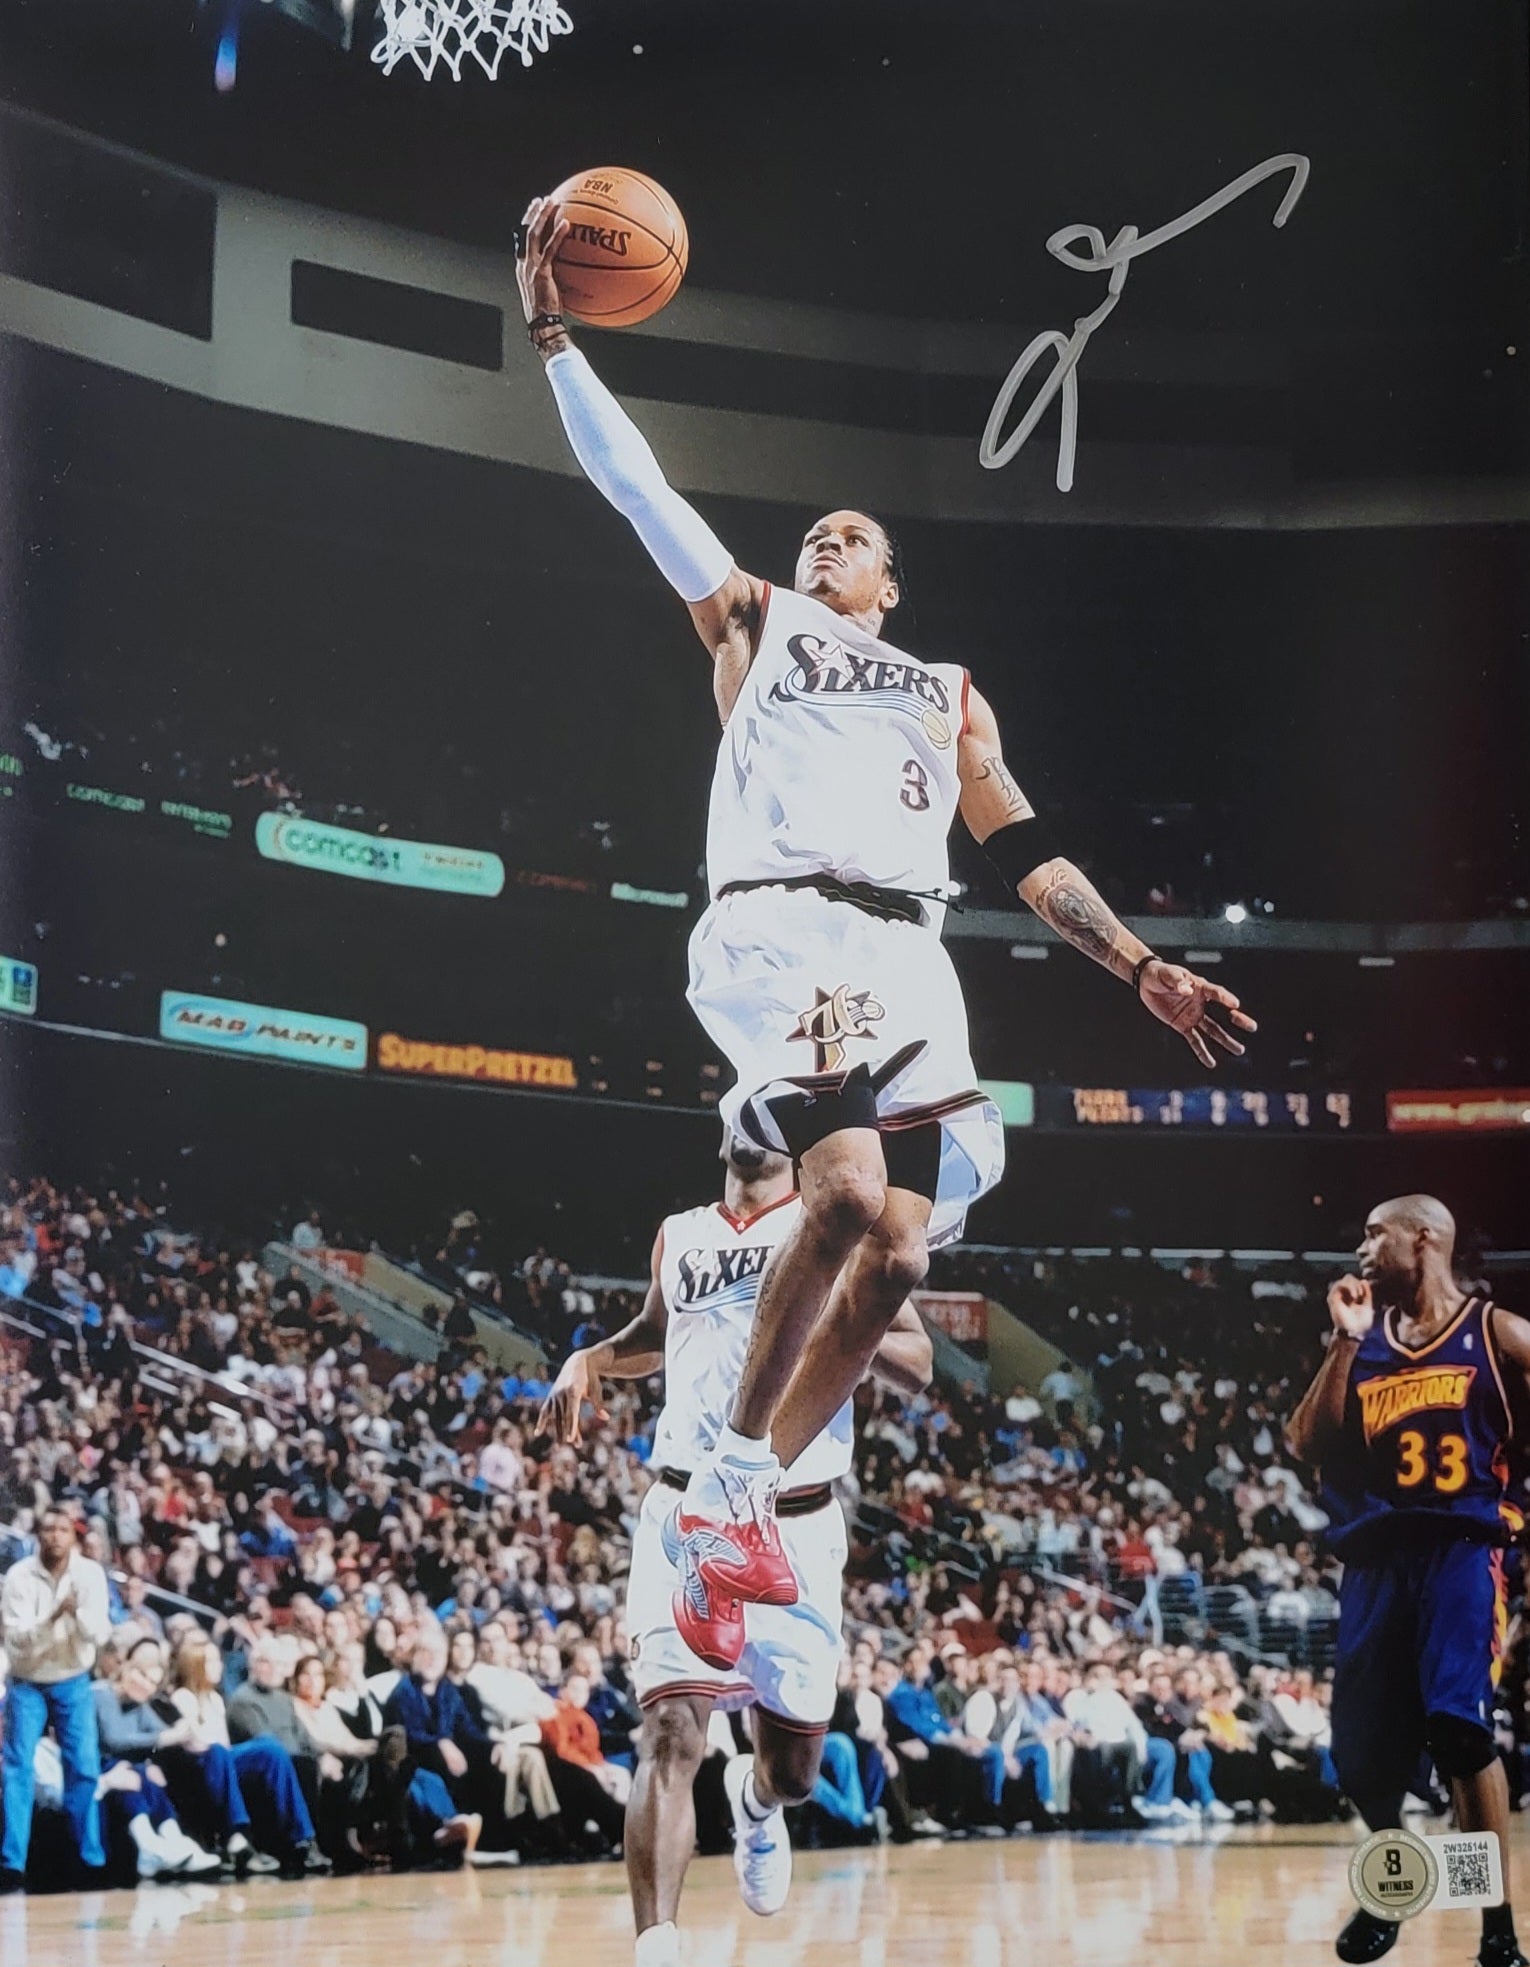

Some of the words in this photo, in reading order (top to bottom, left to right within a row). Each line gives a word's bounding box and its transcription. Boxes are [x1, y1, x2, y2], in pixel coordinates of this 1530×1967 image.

[584, 179, 613, 193] NBA
[767, 633, 950, 715] SIXERS
[899, 759, 930, 812] 3
[1361, 1372, 1469, 1438] WARRIORS
[1397, 1430, 1470, 1494] 33
[1378, 1880, 1414, 1892] WITNESS
